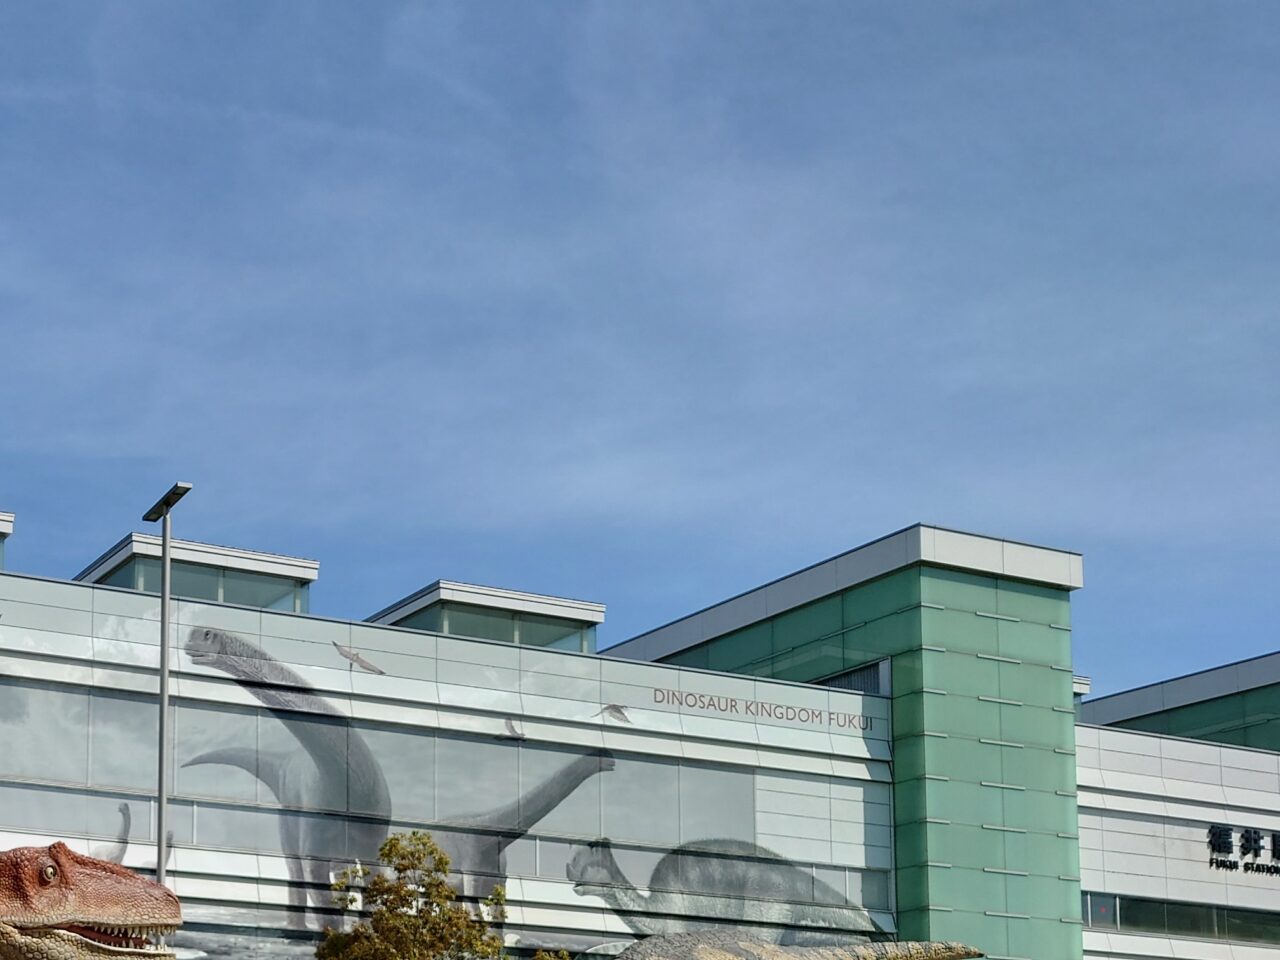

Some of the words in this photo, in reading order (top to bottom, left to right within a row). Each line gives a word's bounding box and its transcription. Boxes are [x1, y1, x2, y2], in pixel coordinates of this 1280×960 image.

[653, 688, 738, 714] DINOSAUR
[745, 701, 822, 725] KINGDOM
[828, 712, 873, 731] FUKUI
[1209, 858, 1239, 869] FUKUI
